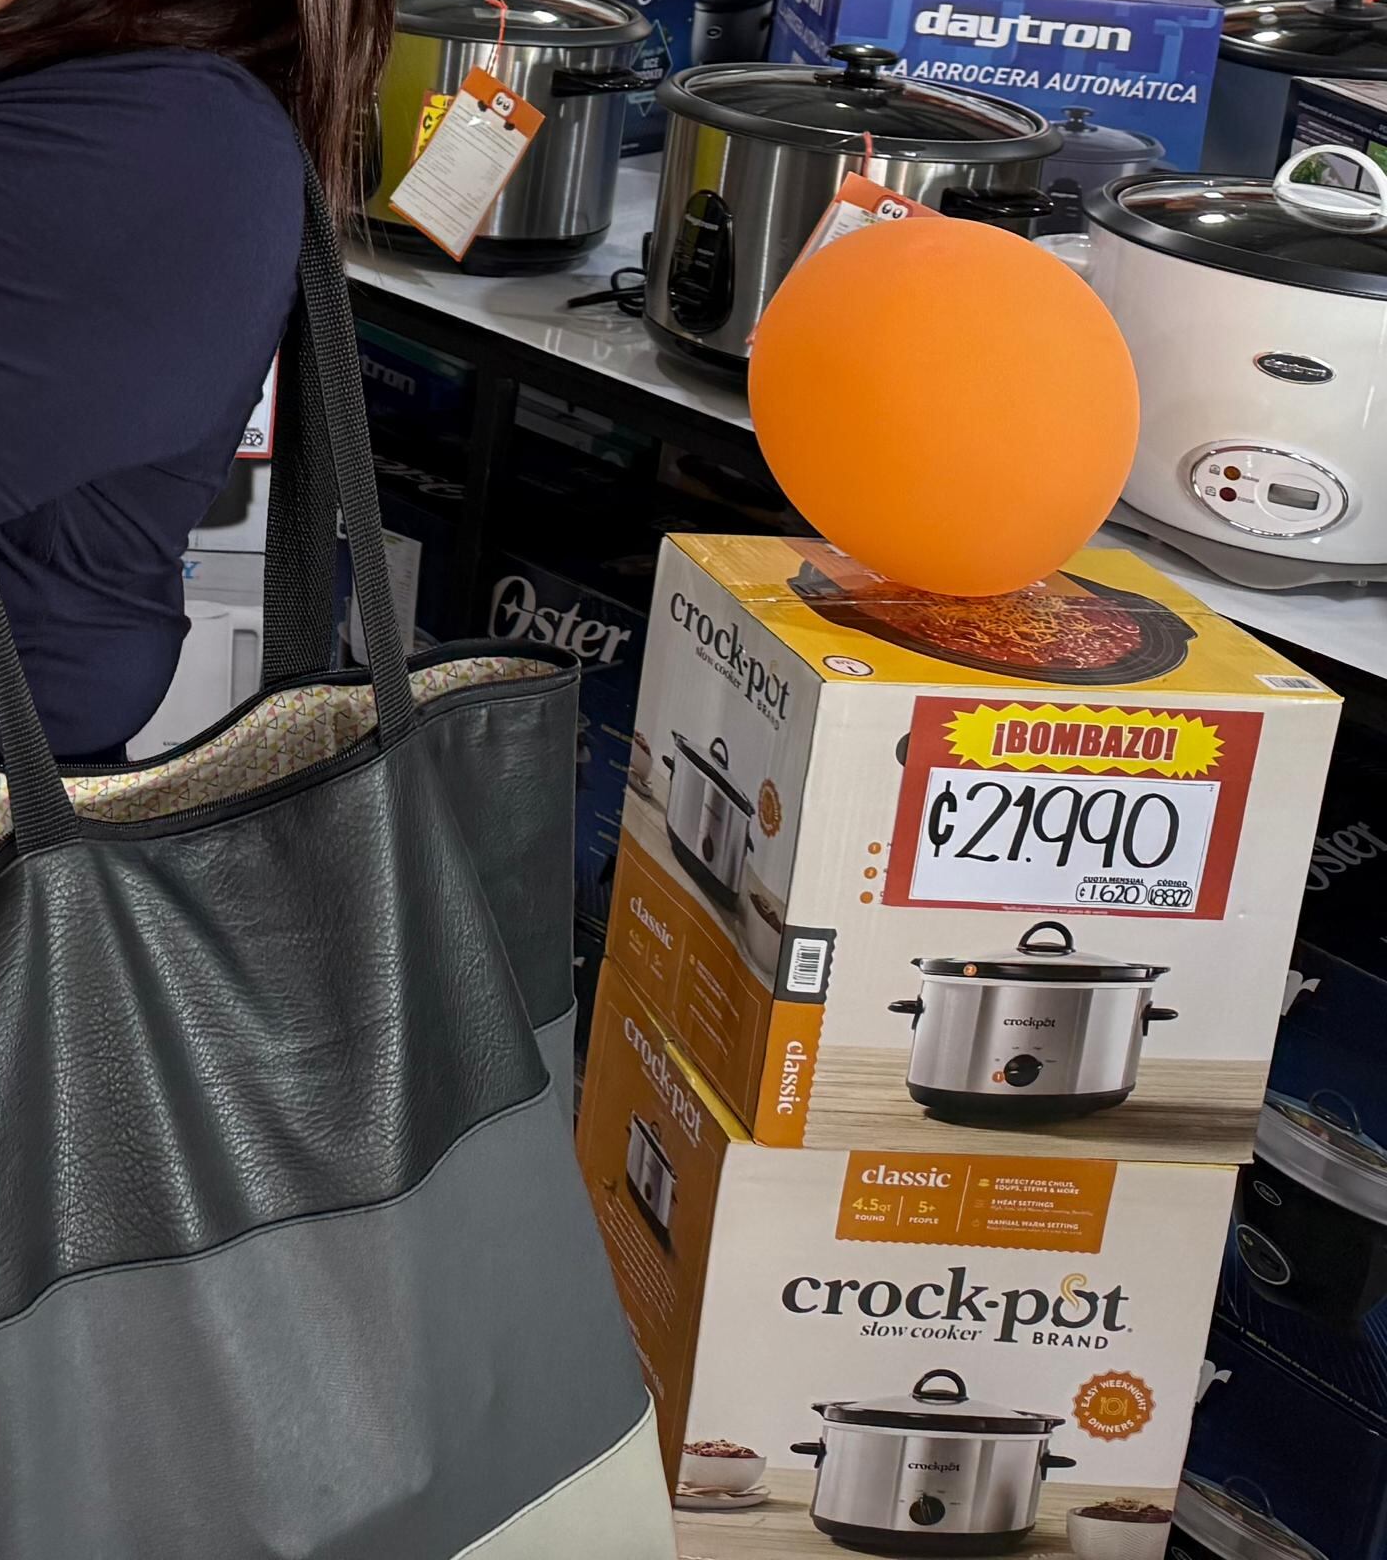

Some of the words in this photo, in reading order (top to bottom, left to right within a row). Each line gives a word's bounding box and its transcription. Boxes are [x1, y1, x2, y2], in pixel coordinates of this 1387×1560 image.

[914, 3, 1132, 52] daytron
[912, 60, 1041, 90] ARROCERA
[1043, 71, 1199, 105] AUTOMÁTICA
[487, 574, 633, 665] Oster
[669, 591, 791, 721] crock-pot
[695, 644, 716, 668] slow
[714, 662, 743, 690] cooker
[991, 719, 1180, 762] ¡BOMBAZO!
[629, 896, 675, 951] classic
[1003, 1016, 1056, 1030] crockpot
[623, 1015, 702, 1144] crock-pot
[777, 1040, 808, 1115] classic
[861, 1164, 952, 1189] classic
[995, 1176, 1029, 1188] PERFECT
[1028, 1178, 1046, 1188] FOR
[1056, 1186, 1080, 1195] MORE
[918, 1200, 937, 1214] 5+
[996, 1199, 1018, 1208] HEAT
[1018, 1200, 1055, 1209] SETTINGS
[854, 1213, 886, 1223] ROUND
[908, 1216, 939, 1226] PEOPLE
[986, 1219, 1020, 1228] MANUAL
[1021, 1221, 1046, 1230] WARM
[1047, 1221, 1080, 1231] SETTING
[781, 1266, 1133, 1343] crock-pot
[859, 1320, 909, 1339] slow
[911, 1323, 983, 1343] cooker
[1032, 1331, 1110, 1351] BRAND
[1080, 1382, 1100, 1410] EASY
[1099, 1379, 1147, 1412] WEEKNIGHT
[1086, 1416, 1135, 1435] DINNERS
[907, 1461, 961, 1473] crockpot
